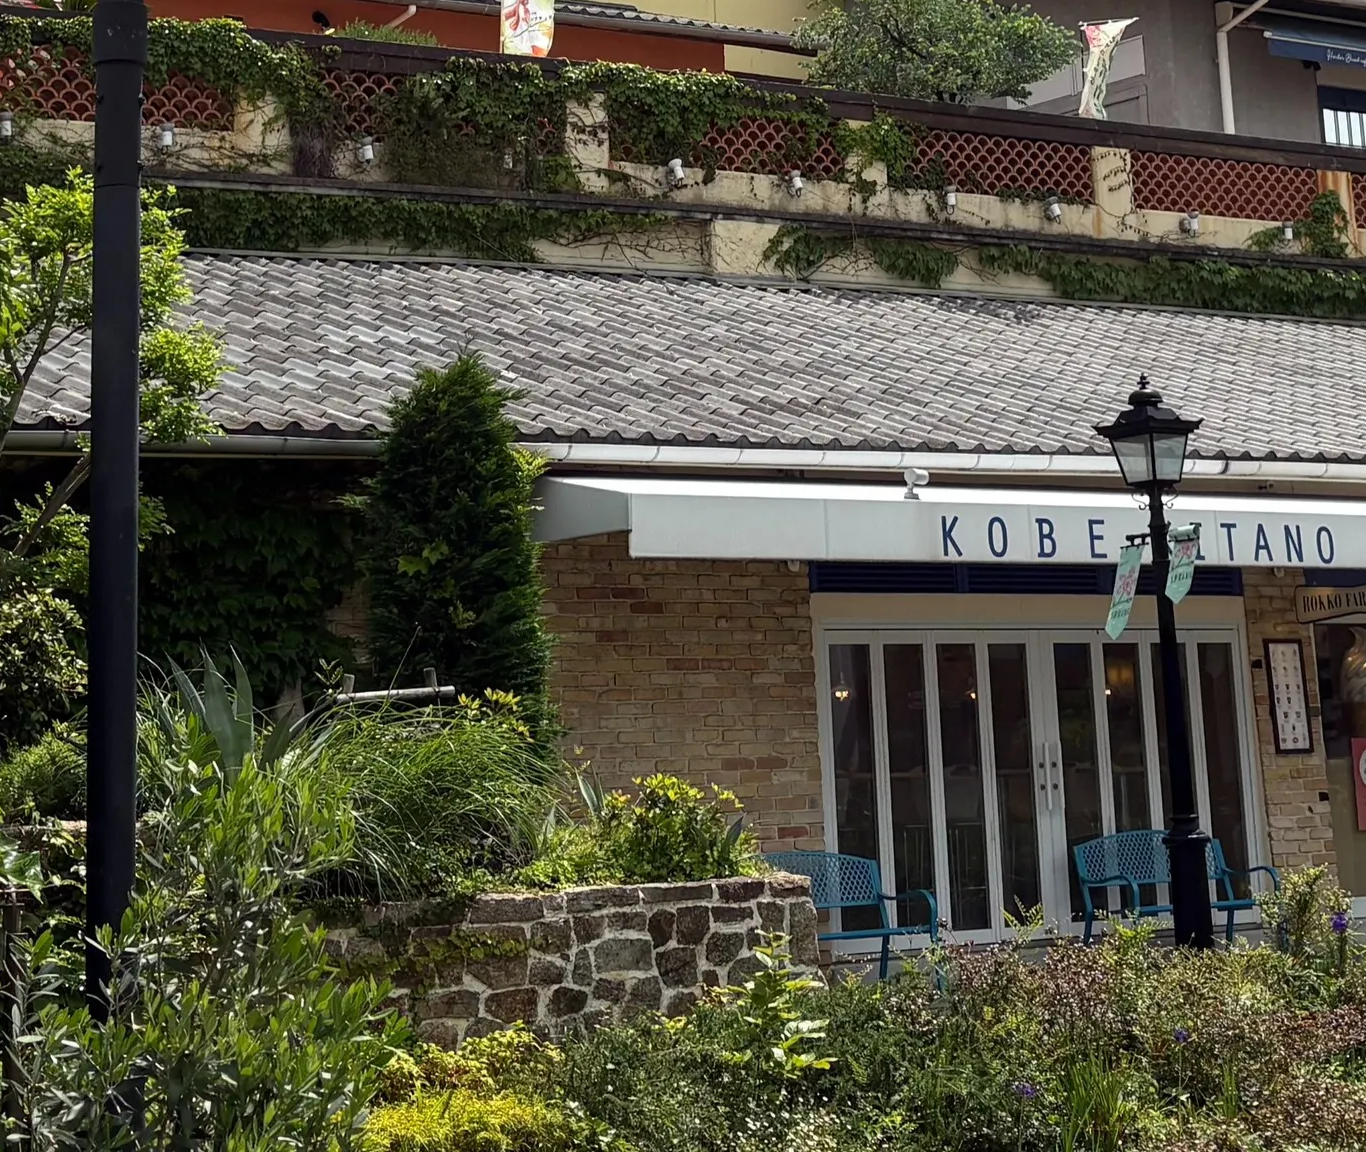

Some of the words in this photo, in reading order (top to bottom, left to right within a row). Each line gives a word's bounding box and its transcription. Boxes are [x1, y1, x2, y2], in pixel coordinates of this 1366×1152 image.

[941, 515, 1108, 559] KOBE
[1160, 522, 1335, 565] ITANO
[1303, 593, 1342, 613] ROKKO
